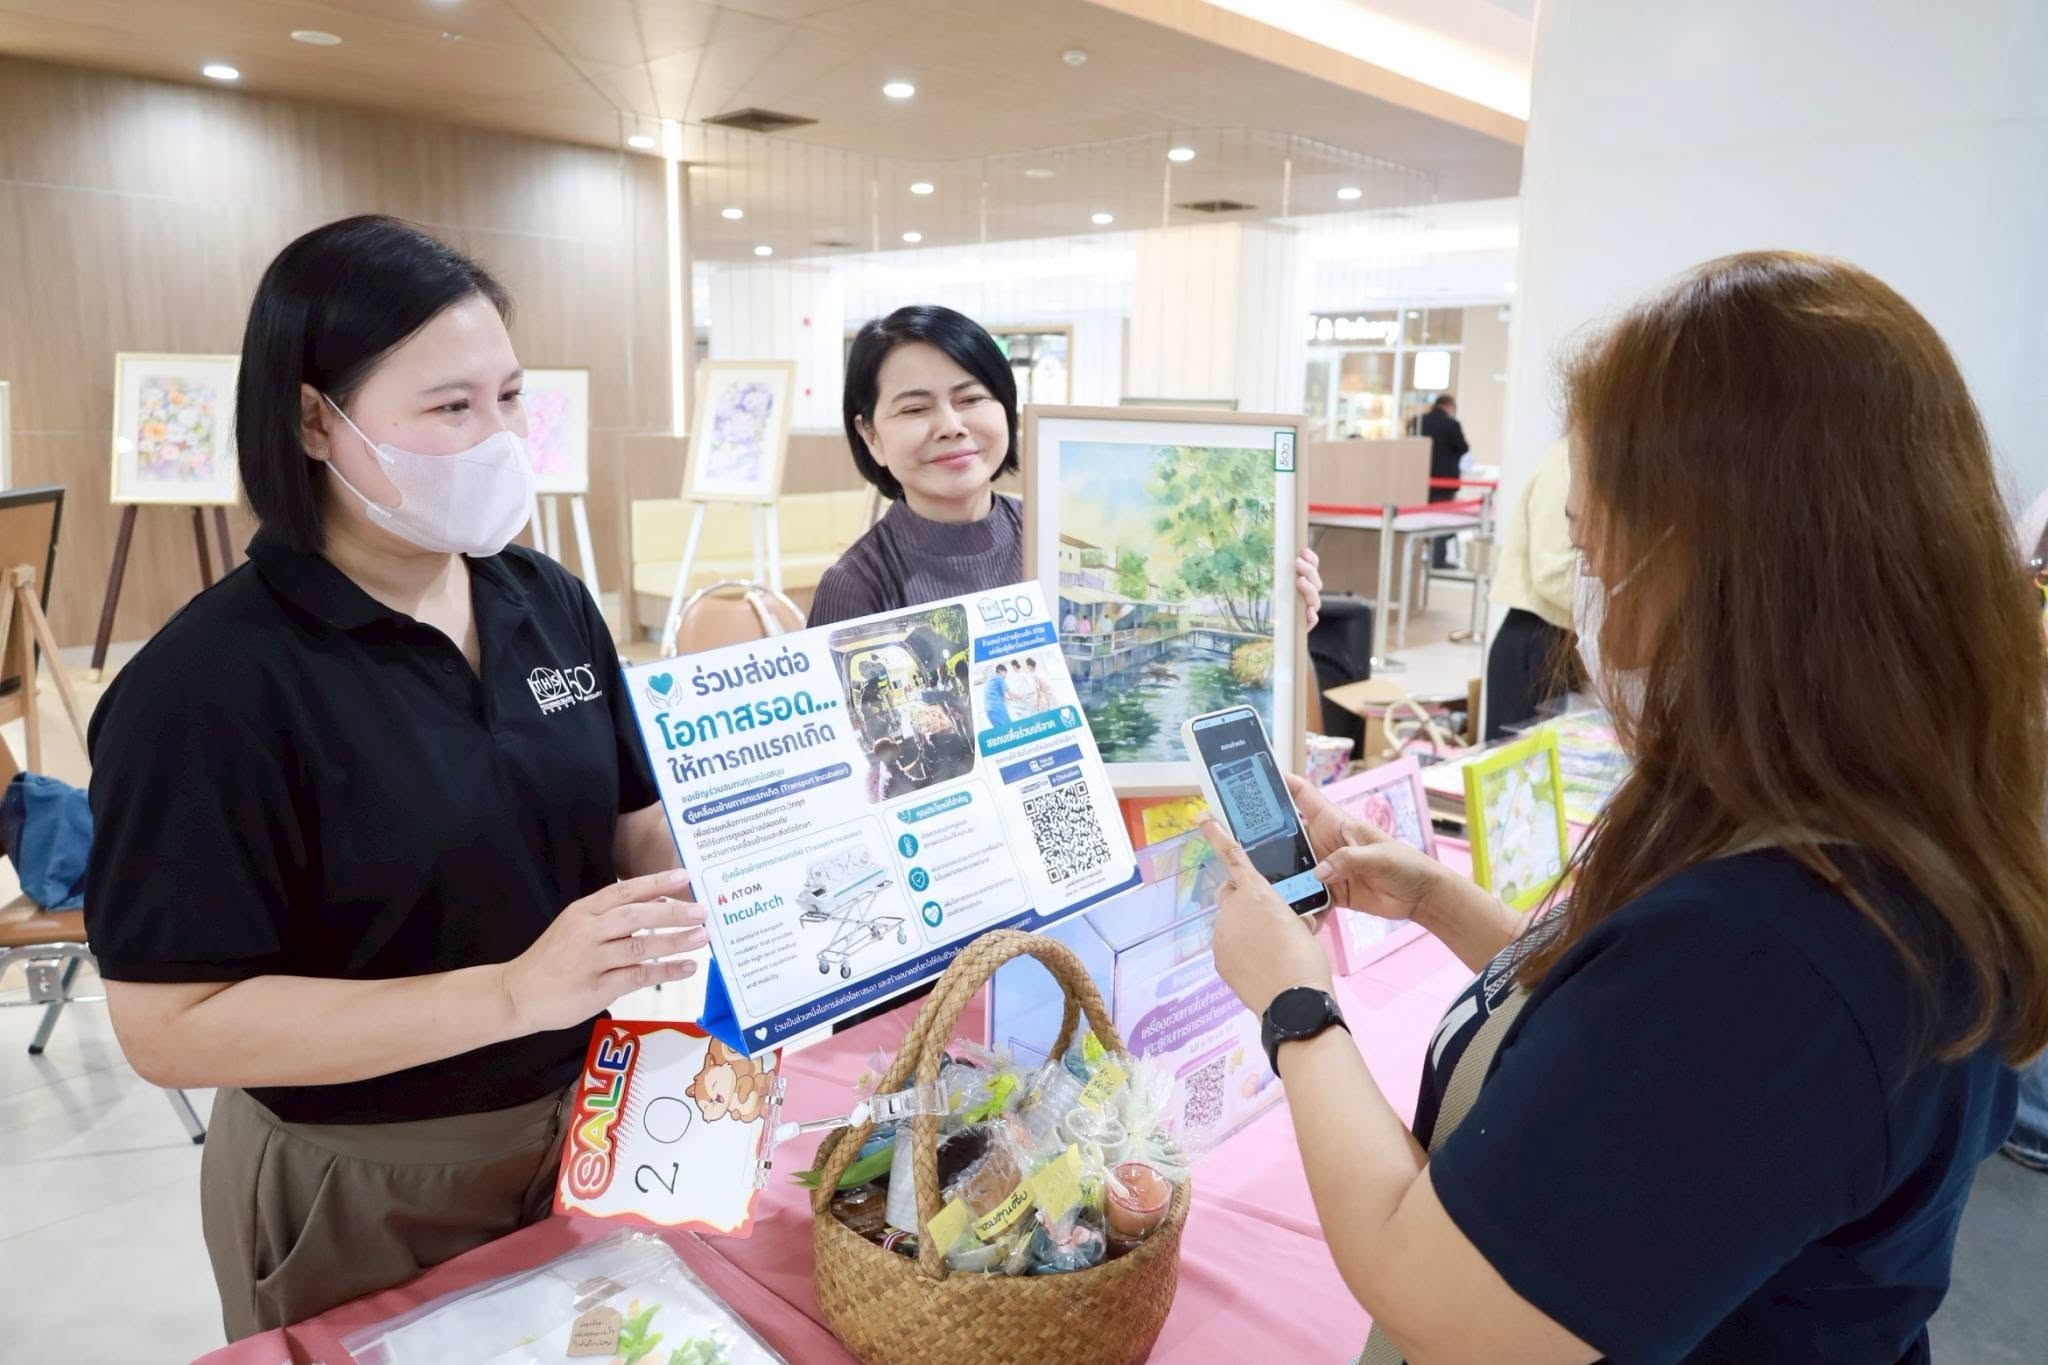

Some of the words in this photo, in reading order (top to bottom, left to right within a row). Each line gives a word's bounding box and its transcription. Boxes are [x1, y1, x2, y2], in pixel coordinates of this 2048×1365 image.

[1001, 596, 1033, 623] 50
[533, 675, 560, 692] THS
[563, 666, 595, 701] 50
[691, 646, 811, 696] ร่วมส่งต่อ
[655, 690, 838, 751] โอกาสรอด...
[666, 721, 836, 784] ให้ทารกแรกเกิด
[723, 895, 784, 925] IncuArch
[732, 883, 762, 901] ATOM
[572, 1036, 634, 1192] SALE
[634, 1096, 693, 1196] 20
